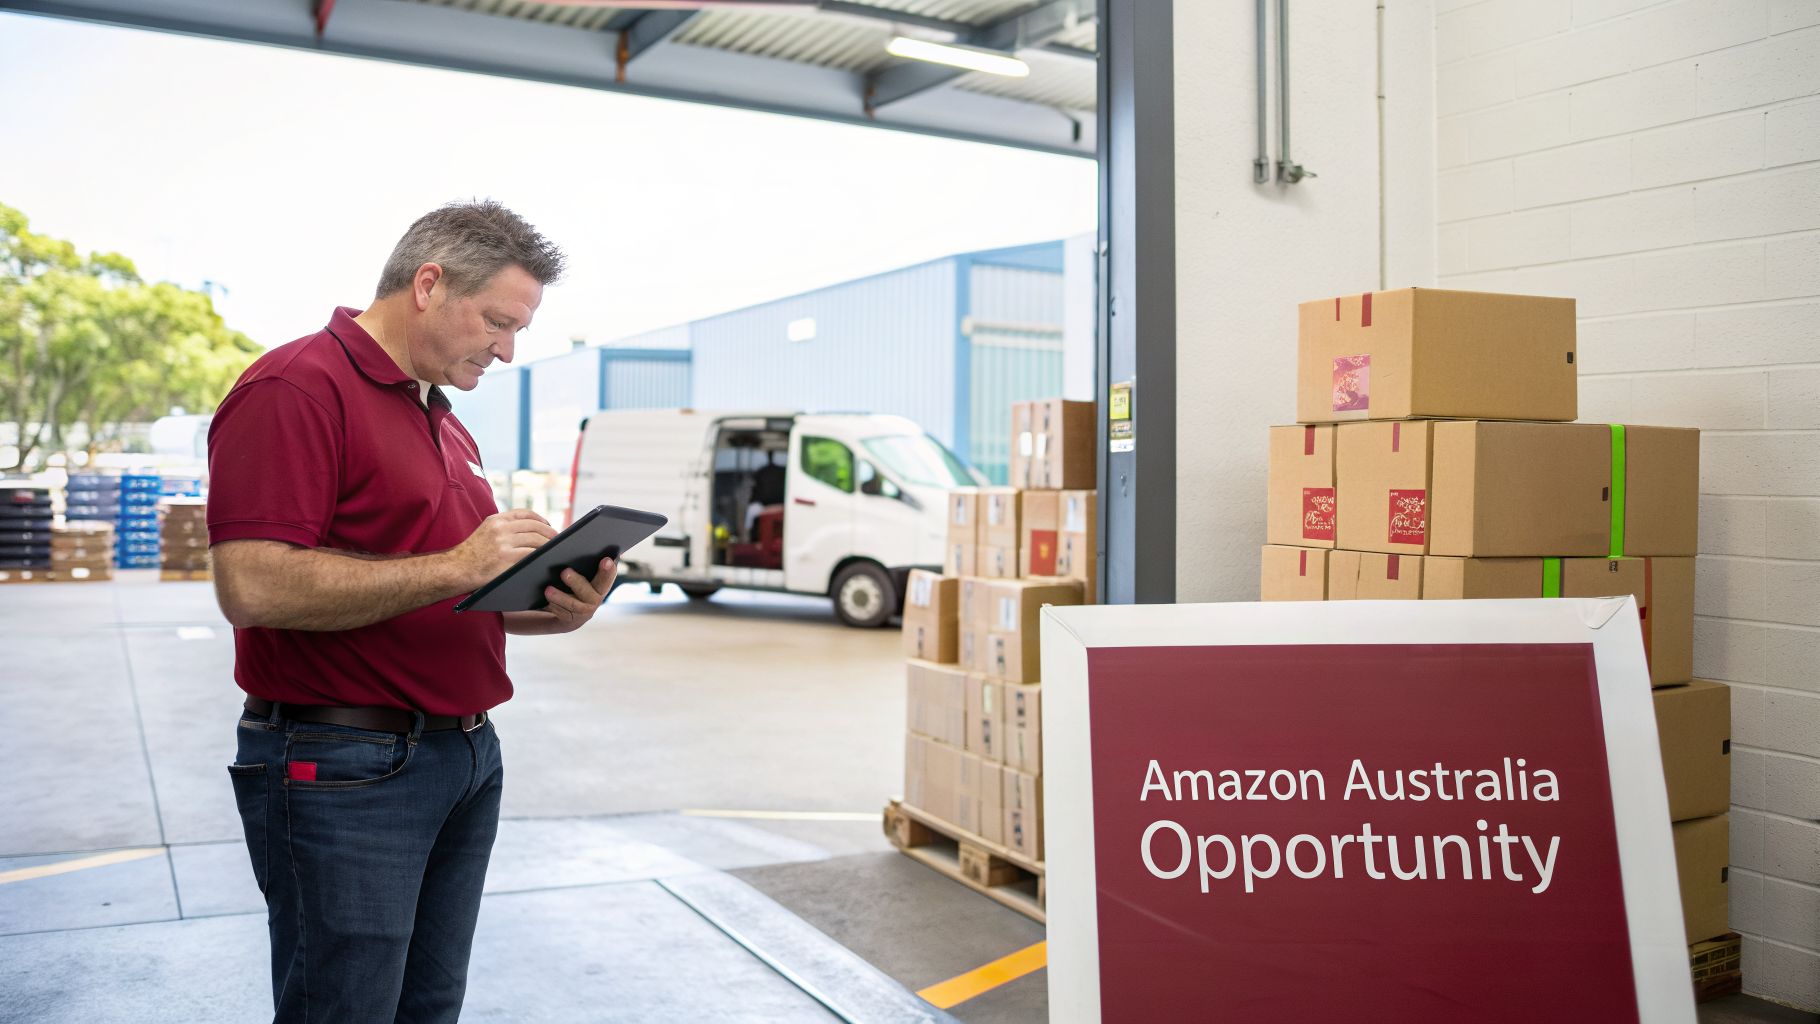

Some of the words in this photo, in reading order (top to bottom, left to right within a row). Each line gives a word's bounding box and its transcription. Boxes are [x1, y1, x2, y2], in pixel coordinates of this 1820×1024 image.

[1139, 759, 1326, 802] Amazon
[1343, 757, 1561, 803] Australia
[1139, 819, 1562, 895] Opportunity
